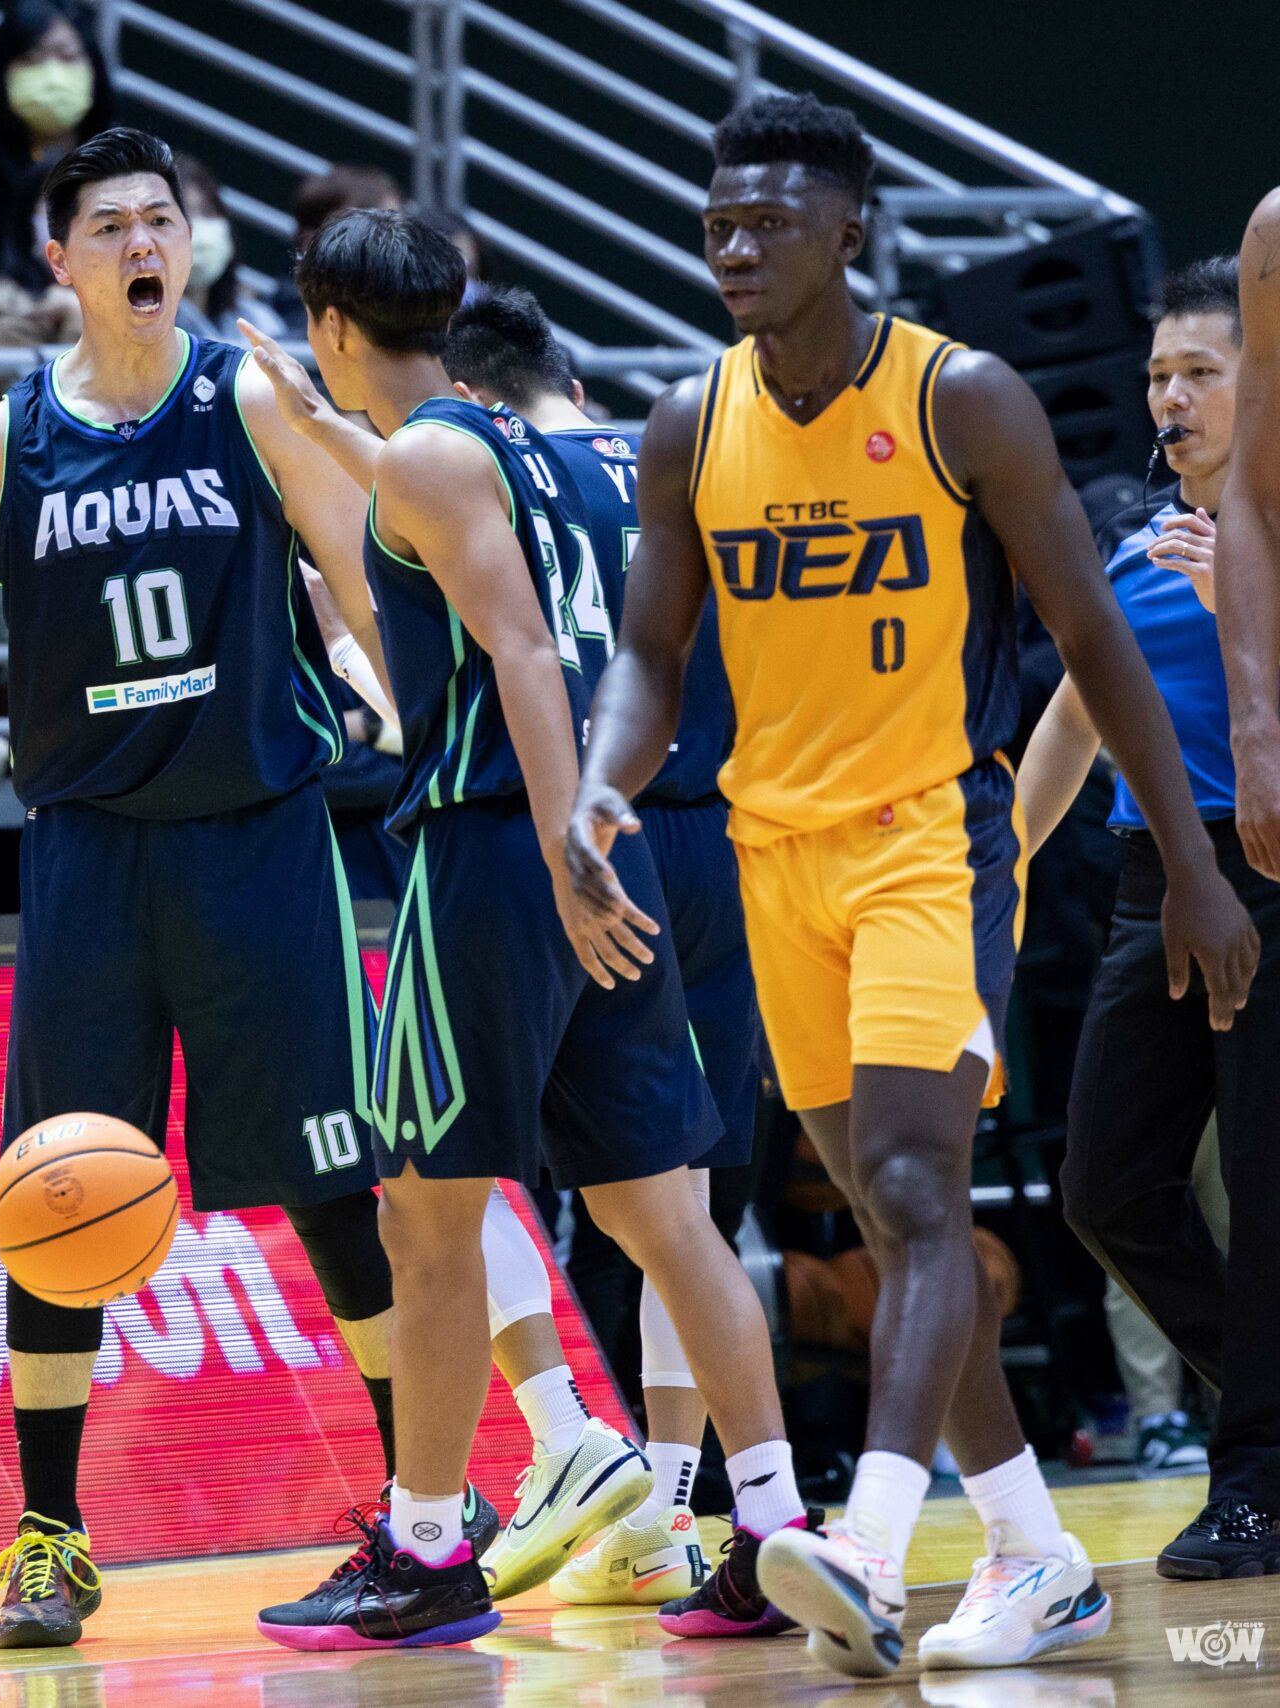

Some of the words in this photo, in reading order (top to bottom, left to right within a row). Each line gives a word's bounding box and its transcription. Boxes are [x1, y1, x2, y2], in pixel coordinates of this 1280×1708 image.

[34, 467, 242, 562] AQUAS
[764, 500, 850, 522] CTBC
[530, 508, 617, 675] 24
[709, 514, 930, 601] DEA
[100, 567, 193, 667] 10
[871, 616, 906, 675] 0
[123, 671, 214, 704] FamilyMart
[302, 1109, 361, 1174] 10
